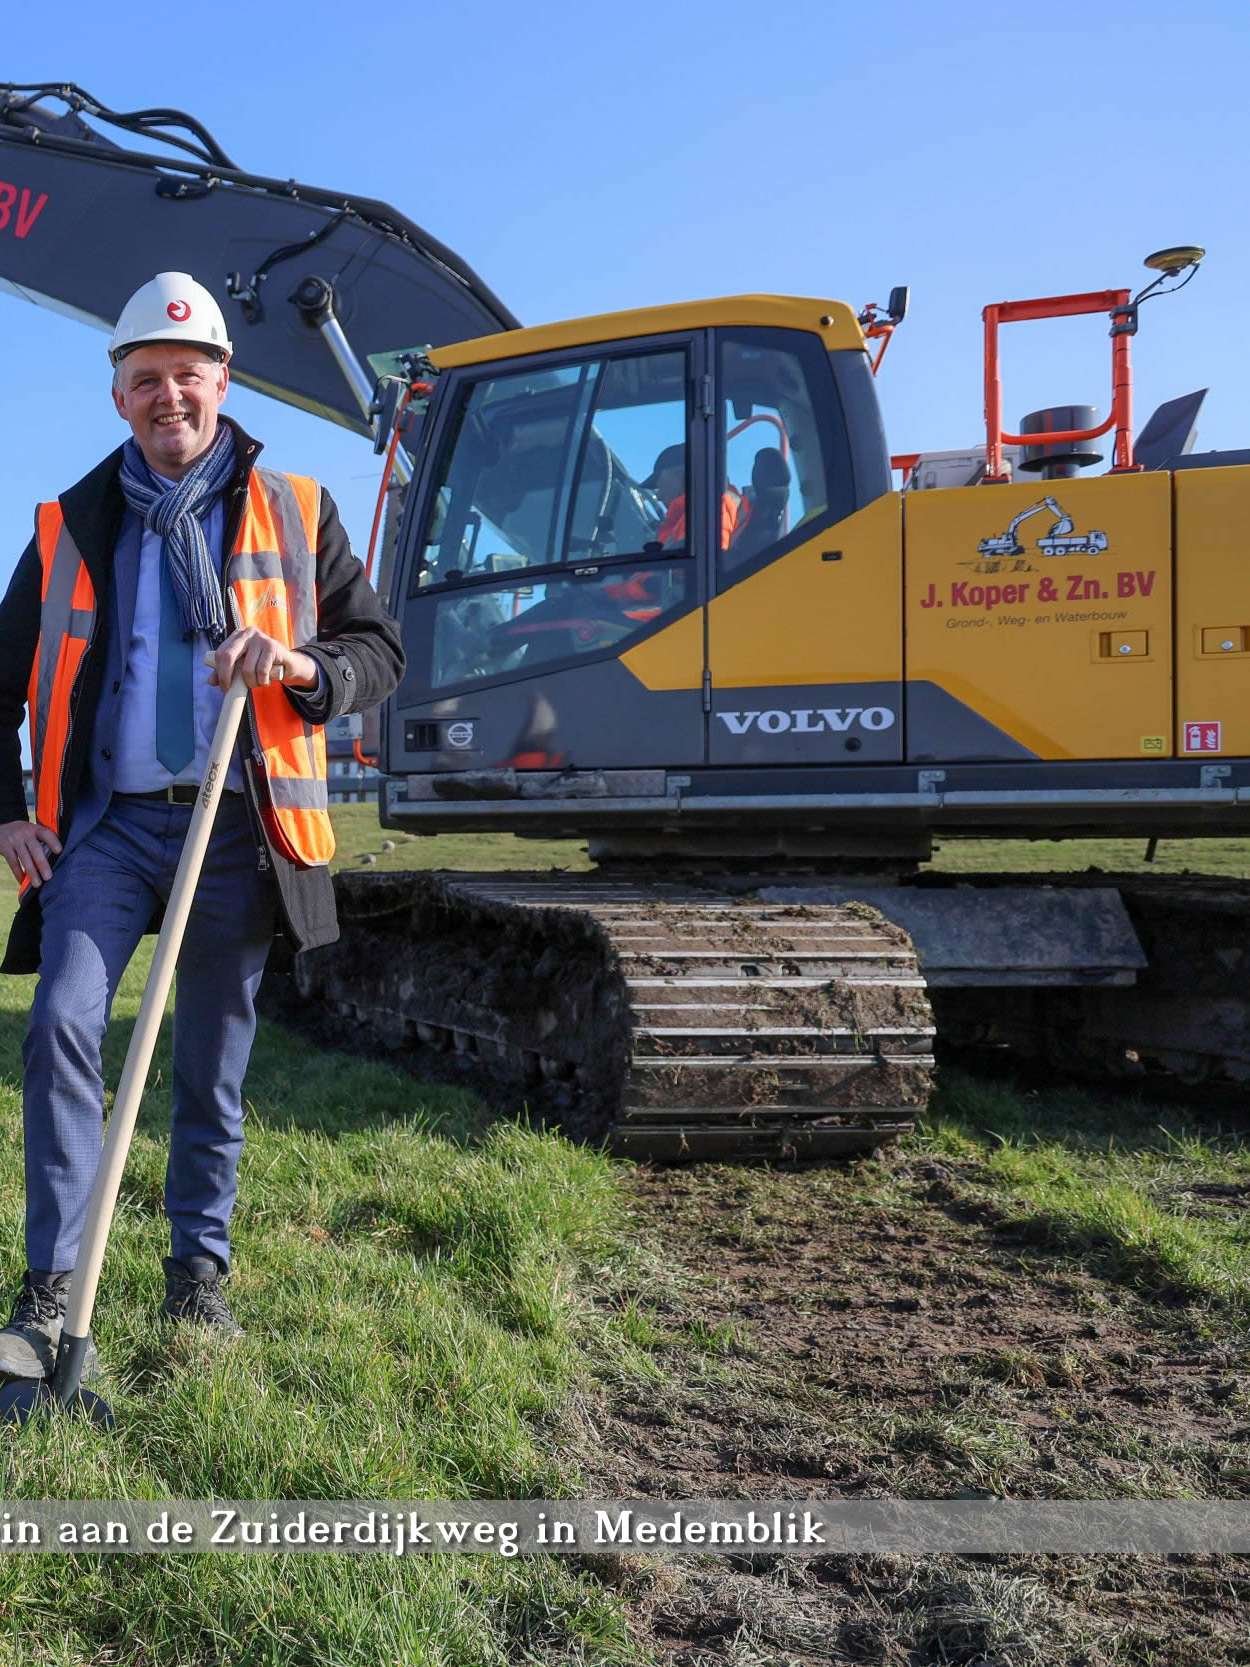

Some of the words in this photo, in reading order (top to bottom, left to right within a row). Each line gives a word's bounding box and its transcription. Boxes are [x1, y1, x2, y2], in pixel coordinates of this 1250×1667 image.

[919, 583, 943, 609] J.
[951, 580, 1031, 611] Koper
[1037, 576, 1059, 603] &
[1065, 574, 1109, 601] Zn.
[1116, 570, 1157, 598] BV
[1034, 614, 1050, 624] en
[1054, 609, 1128, 623] Waterbouw
[716, 706, 895, 734] VOLVO
